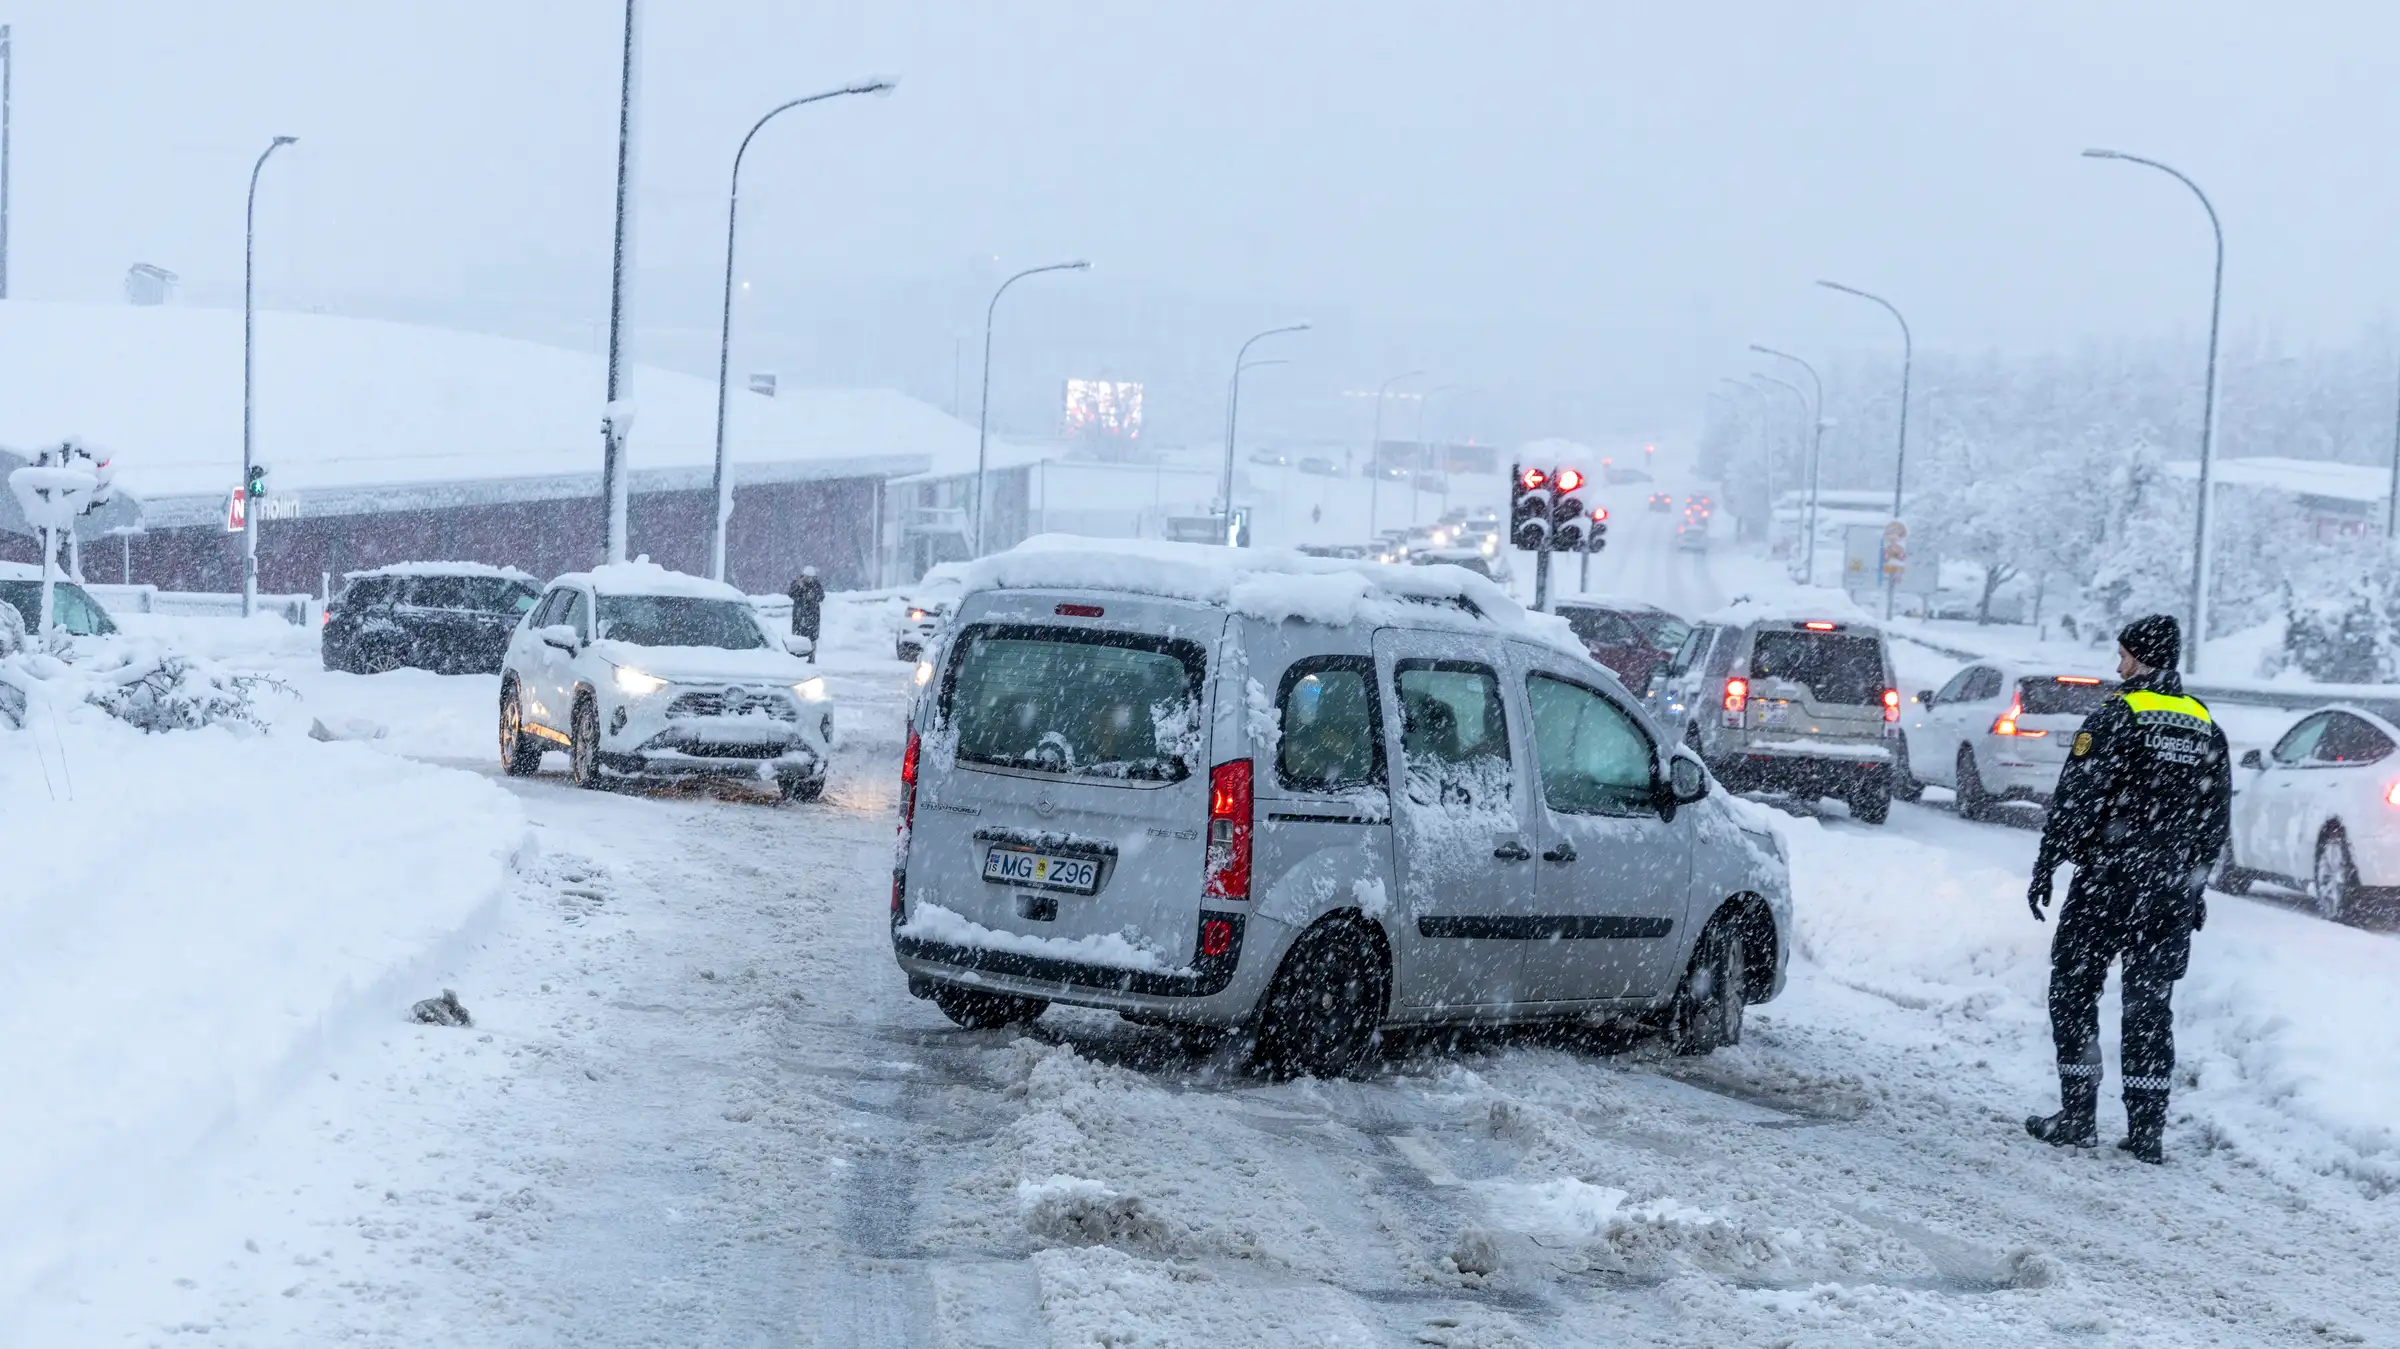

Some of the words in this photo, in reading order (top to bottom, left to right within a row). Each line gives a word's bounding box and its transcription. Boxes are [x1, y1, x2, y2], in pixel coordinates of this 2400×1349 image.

[2144, 732, 2209, 755] LÖGREGLAN
[2157, 751, 2197, 765] POLICE
[988, 863, 998, 872] IS
[1000, 854, 1033, 879] MG
[1048, 860, 1094, 885] Z96
